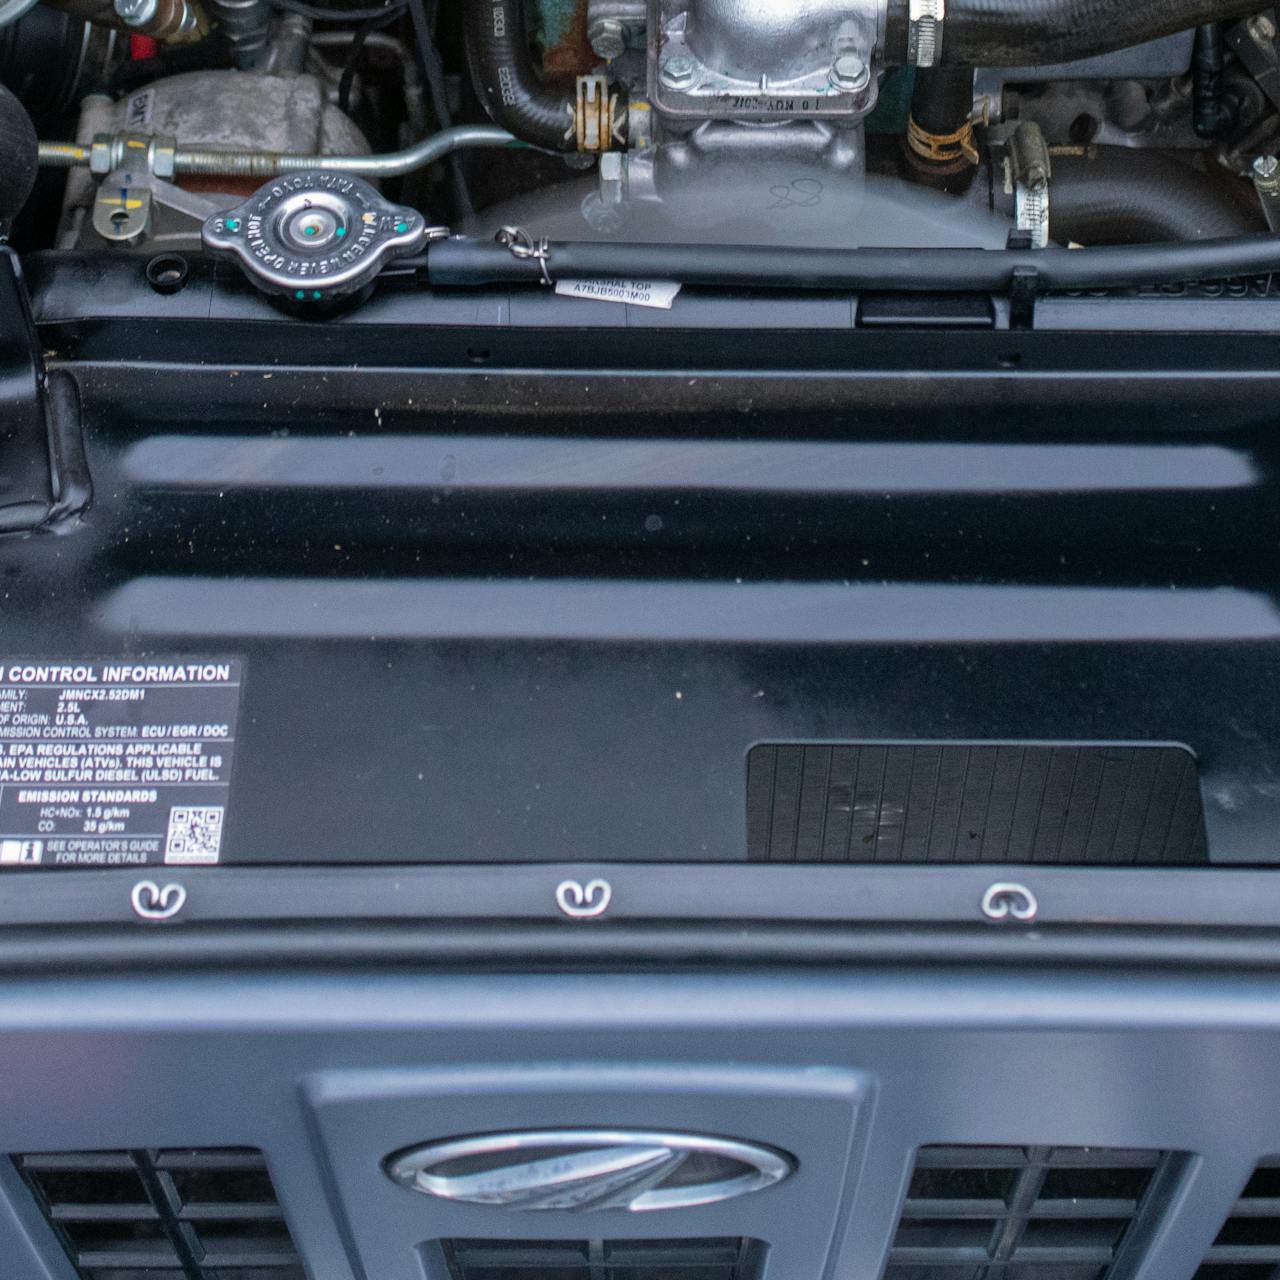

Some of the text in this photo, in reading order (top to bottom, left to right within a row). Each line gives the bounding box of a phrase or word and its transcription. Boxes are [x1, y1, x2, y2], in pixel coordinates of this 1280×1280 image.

[9, 666, 98, 682] CONTROL
[102, 665, 230, 682] INFORMATION
[11, 714, 51, 726] ORIGIN:
[55, 714, 88, 725] U.S.A.
[43, 726, 92, 738] CONTROL
[9, 743, 34, 755] EPA
[36, 743, 123, 756] REGULATIONS
[125, 743, 202, 755] APPLICABLE
[18, 756, 78, 768] VEHICLES
[126, 755, 155, 768] THIS
[156, 755, 208, 768] VEHICLE
[210, 755, 222, 768] IS
[44, 769, 93, 781] SULFUR
[95, 769, 139, 781] DIESEL
[141, 768, 182, 782] (ULSD)
[184, 768, 220, 781] FUEL.
[18, 790, 158, 803] EMISSION STANDARDS
[103, 807, 130, 819] g/km
[38, 821, 125, 834] CO: 35 g/km
[46, 840, 65, 852] SEE
[129, 840, 160, 852] GUIDE
[56, 852, 147, 864] FOR MORE DETAILS
